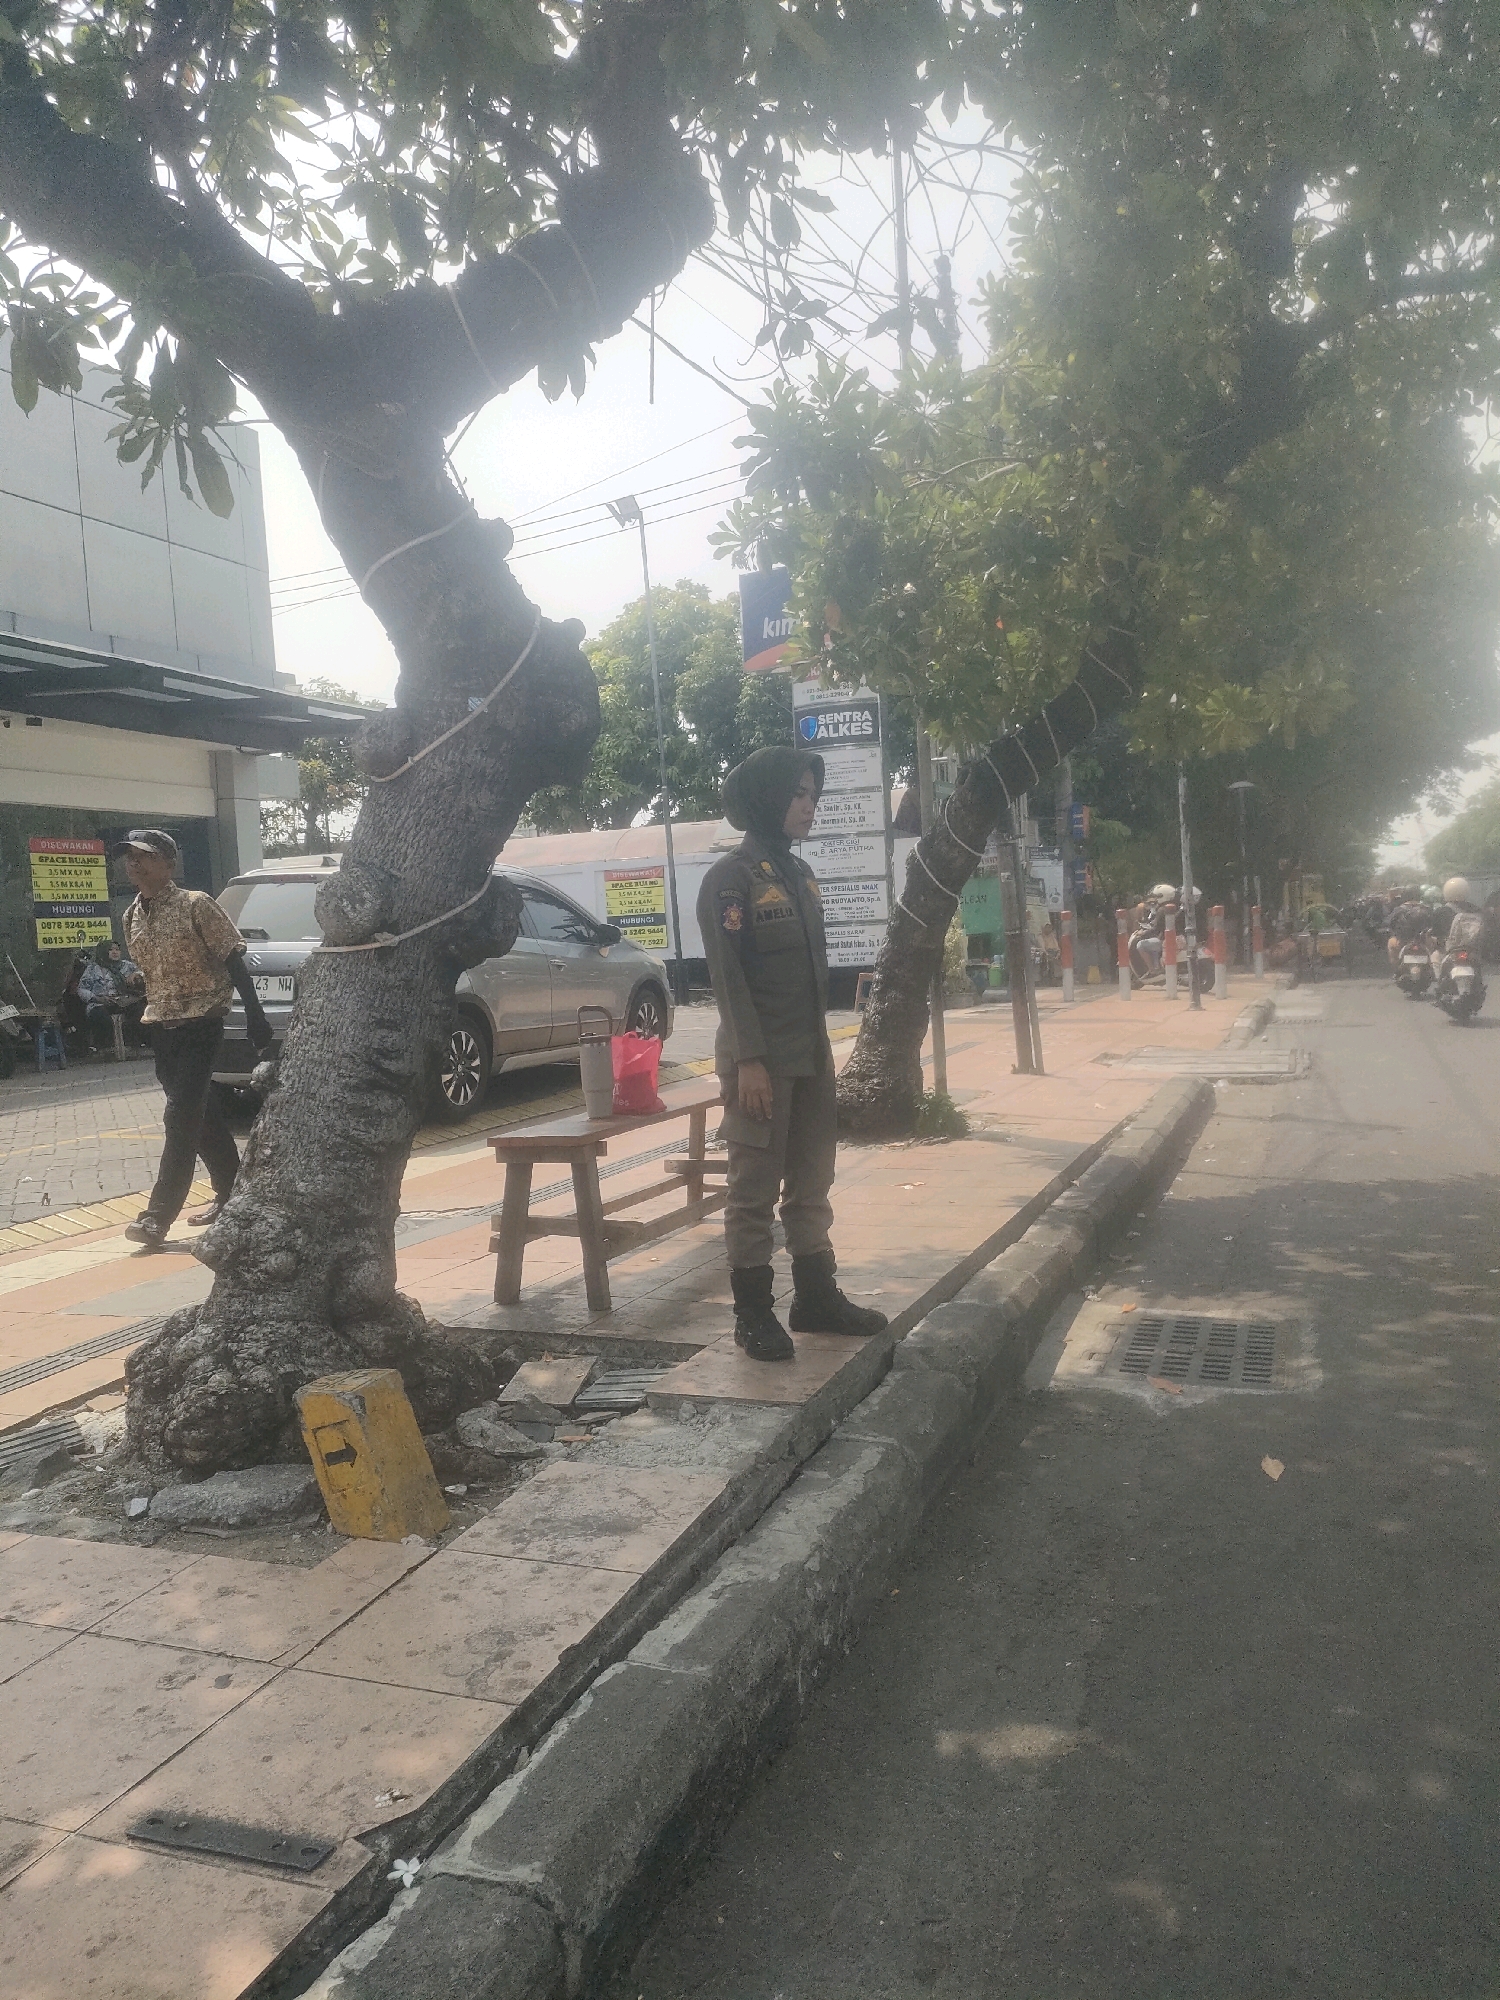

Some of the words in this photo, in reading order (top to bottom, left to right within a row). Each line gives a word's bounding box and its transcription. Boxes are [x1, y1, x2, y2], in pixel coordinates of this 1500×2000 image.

[818, 710, 873, 725] SENTRA
[816, 721, 873, 739] ALKES
[40, 840, 94, 851] DISEWAKAN
[828, 846, 848, 854] ARYA
[38, 855, 67, 864] SPACE
[67, 856, 100, 865] RUANG
[612, 869, 656, 878] DISEWAKAN
[830, 884, 860, 892] SPESIALIS
[52, 905, 96, 914] HUBUNGI
[620, 916, 654, 925] HUBUNGI
[41, 921, 63, 930] 0878
